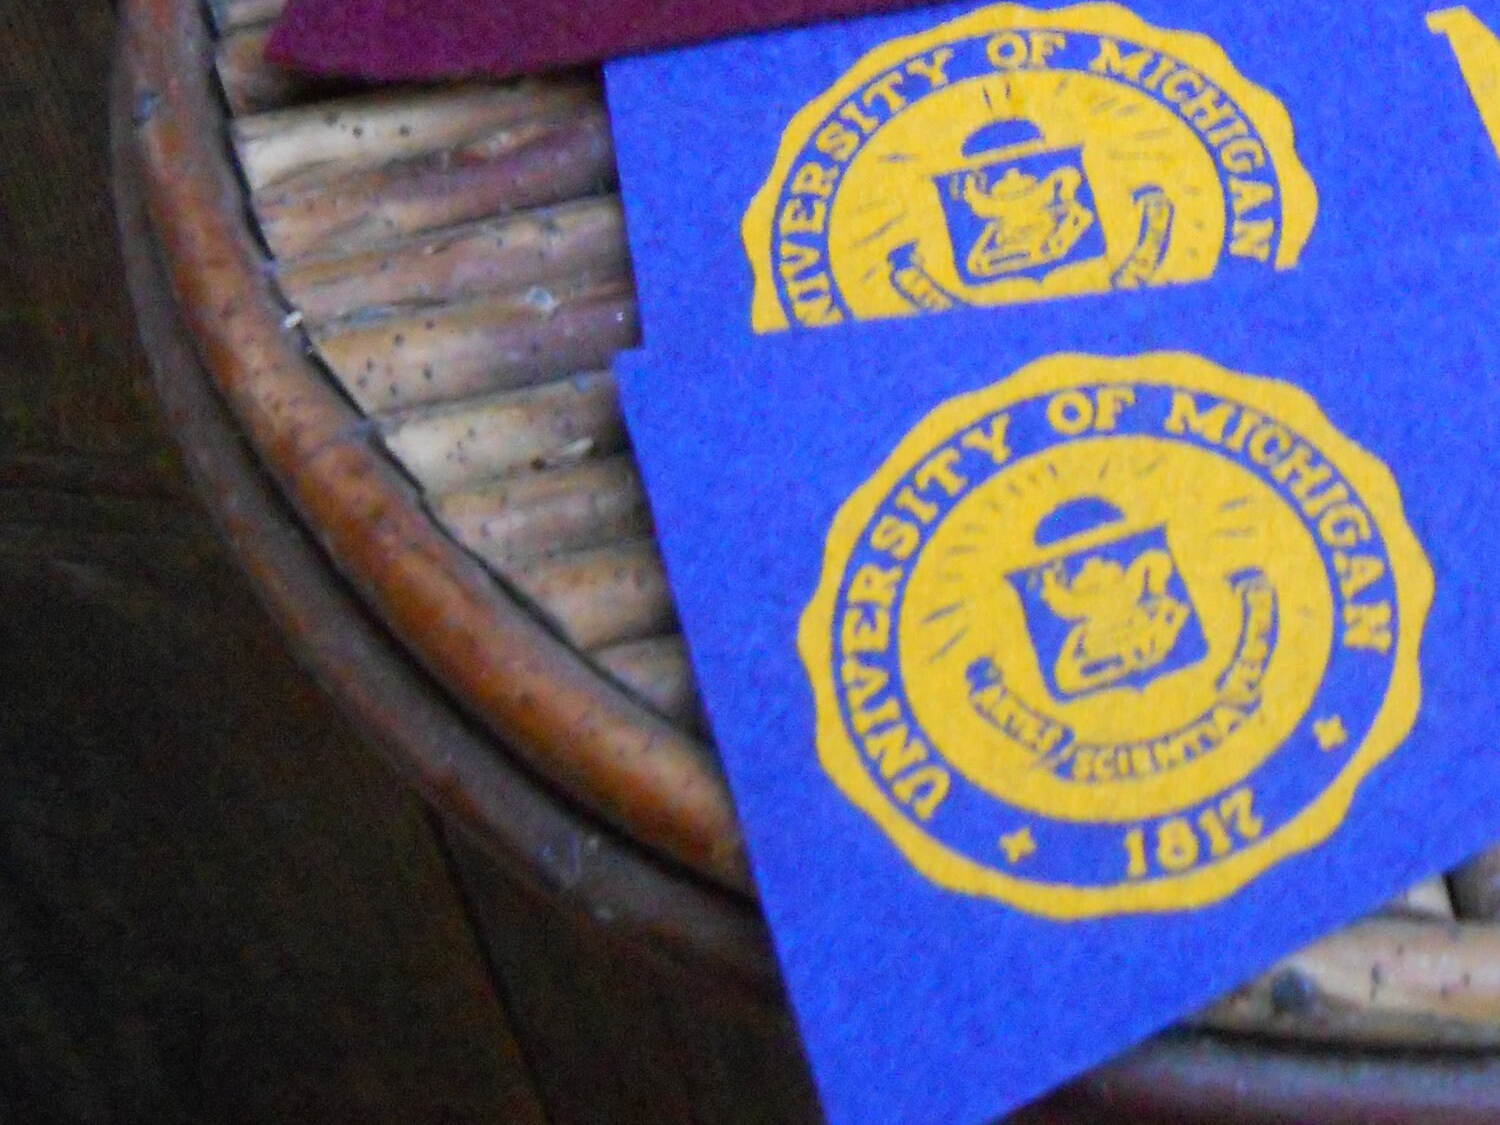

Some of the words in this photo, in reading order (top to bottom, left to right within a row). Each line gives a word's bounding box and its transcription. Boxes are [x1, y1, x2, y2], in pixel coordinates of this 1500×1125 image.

[778, 50, 954, 329] NIVERSITY
[986, 30, 1066, 67] OF
[1089, 38, 1276, 264] MICHIGAN
[841, 415, 1010, 820] UNIVERSITY
[1046, 387, 1134, 433] OF
[1164, 390, 1392, 653] MICHIGAN
[1124, 787, 1262, 879] 1817
